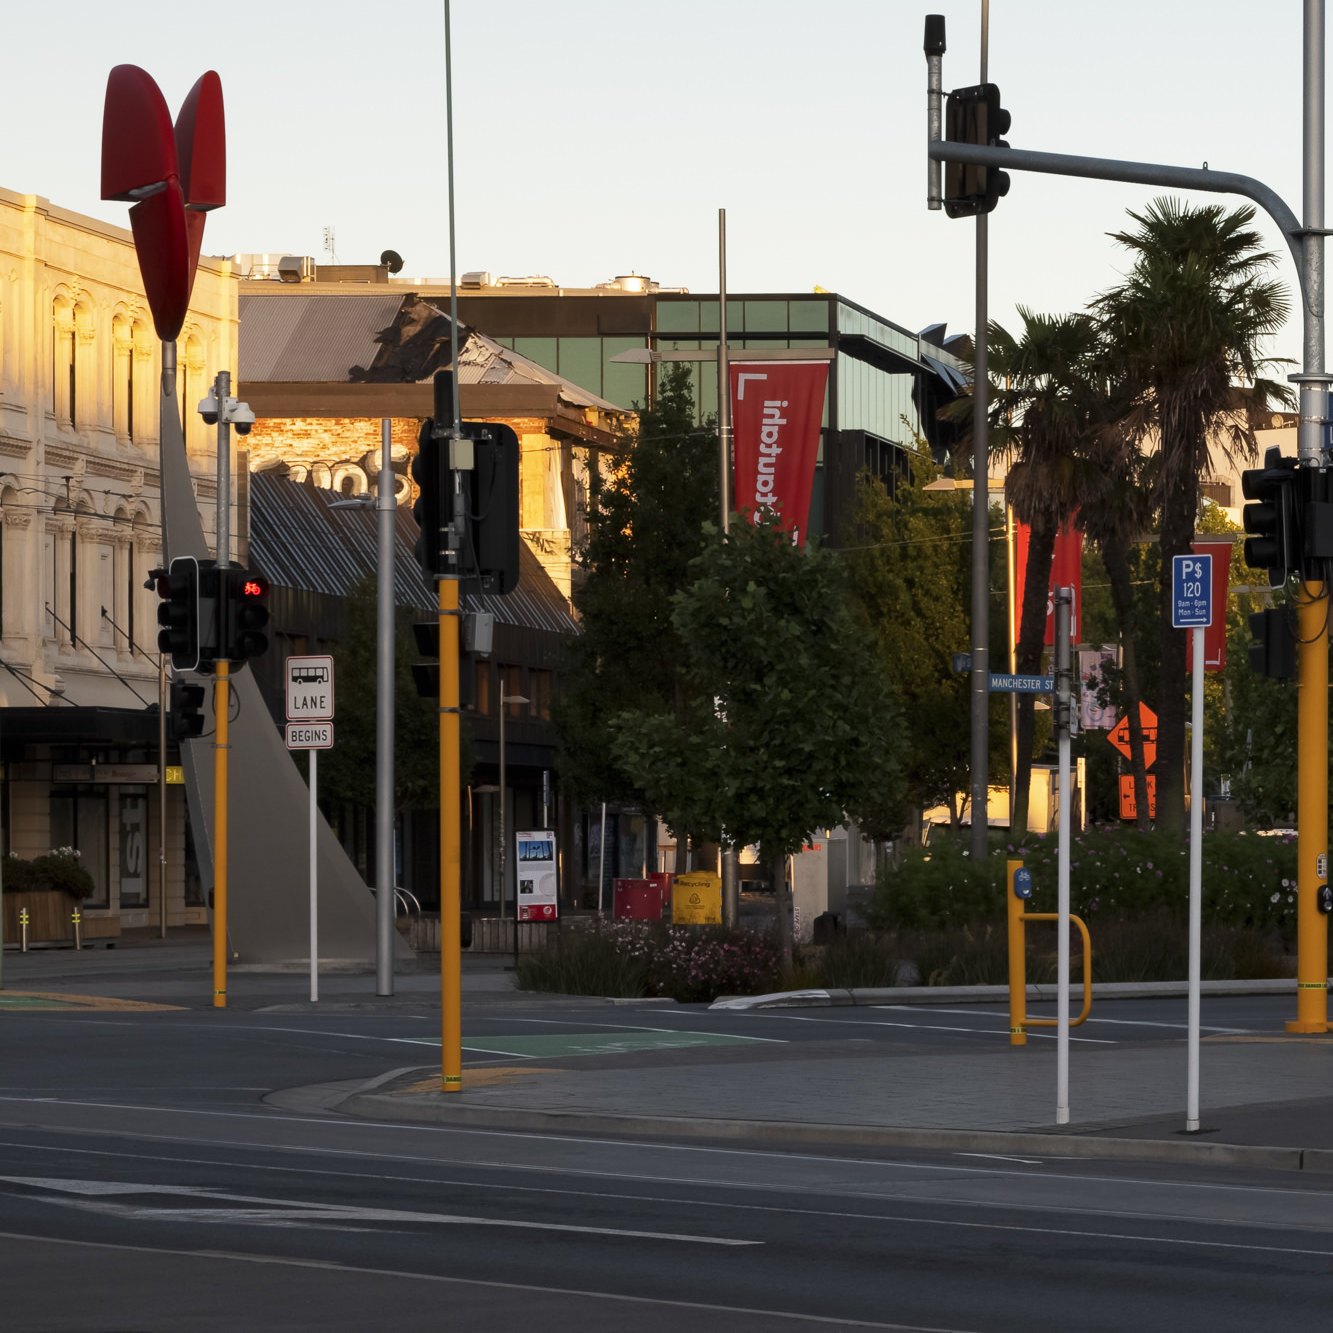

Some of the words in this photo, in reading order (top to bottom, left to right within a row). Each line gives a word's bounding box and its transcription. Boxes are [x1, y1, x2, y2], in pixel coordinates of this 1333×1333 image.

[1183, 582, 1201, 597] 120
[1177, 600, 1190, 608] 9am
[1194, 599, 1207, 608] 6pm
[1195, 608, 1207, 616] Sun
[991, 677, 1041, 690] MANCHESTER
[1044, 680, 1054, 690] ST
[294, 695, 326, 710] LANE
[291, 729, 328, 742] BEGINS
